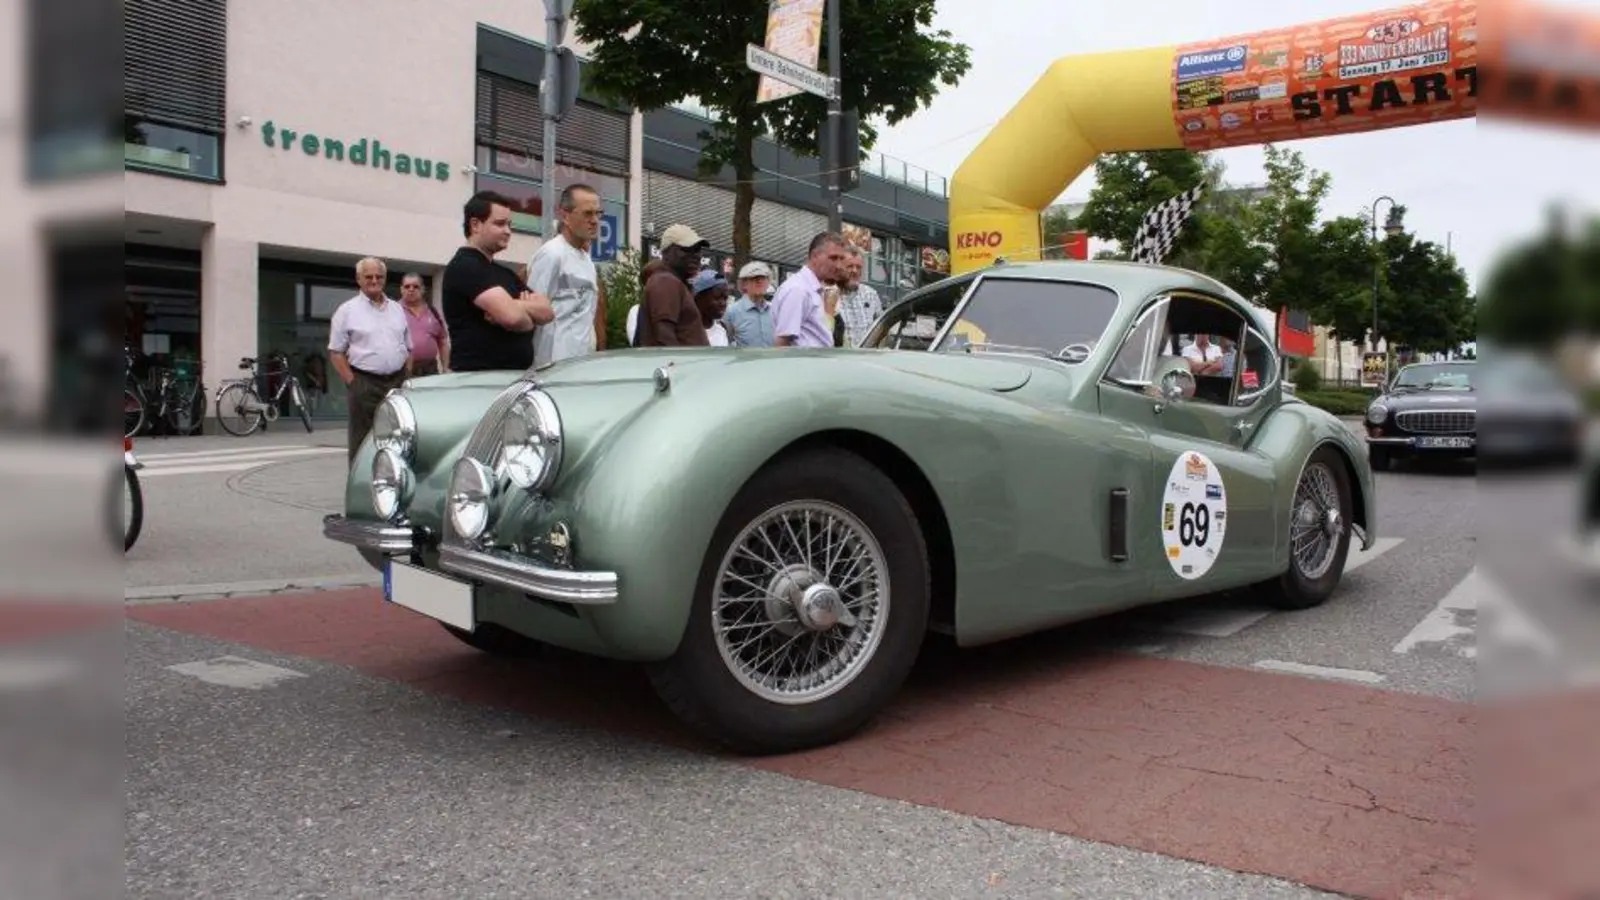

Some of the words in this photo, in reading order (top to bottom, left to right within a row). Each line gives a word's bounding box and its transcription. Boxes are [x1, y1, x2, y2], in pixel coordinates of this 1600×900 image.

[1180, 52, 1226, 67] Allianz
[1359, 39, 1405, 63] MINUTEN
[1407, 26, 1447, 56] RALLYE
[261, 120, 449, 181] trendhaus
[597, 221, 612, 252] P
[956, 231, 1002, 250] KENO
[1180, 502, 1210, 547] 69
